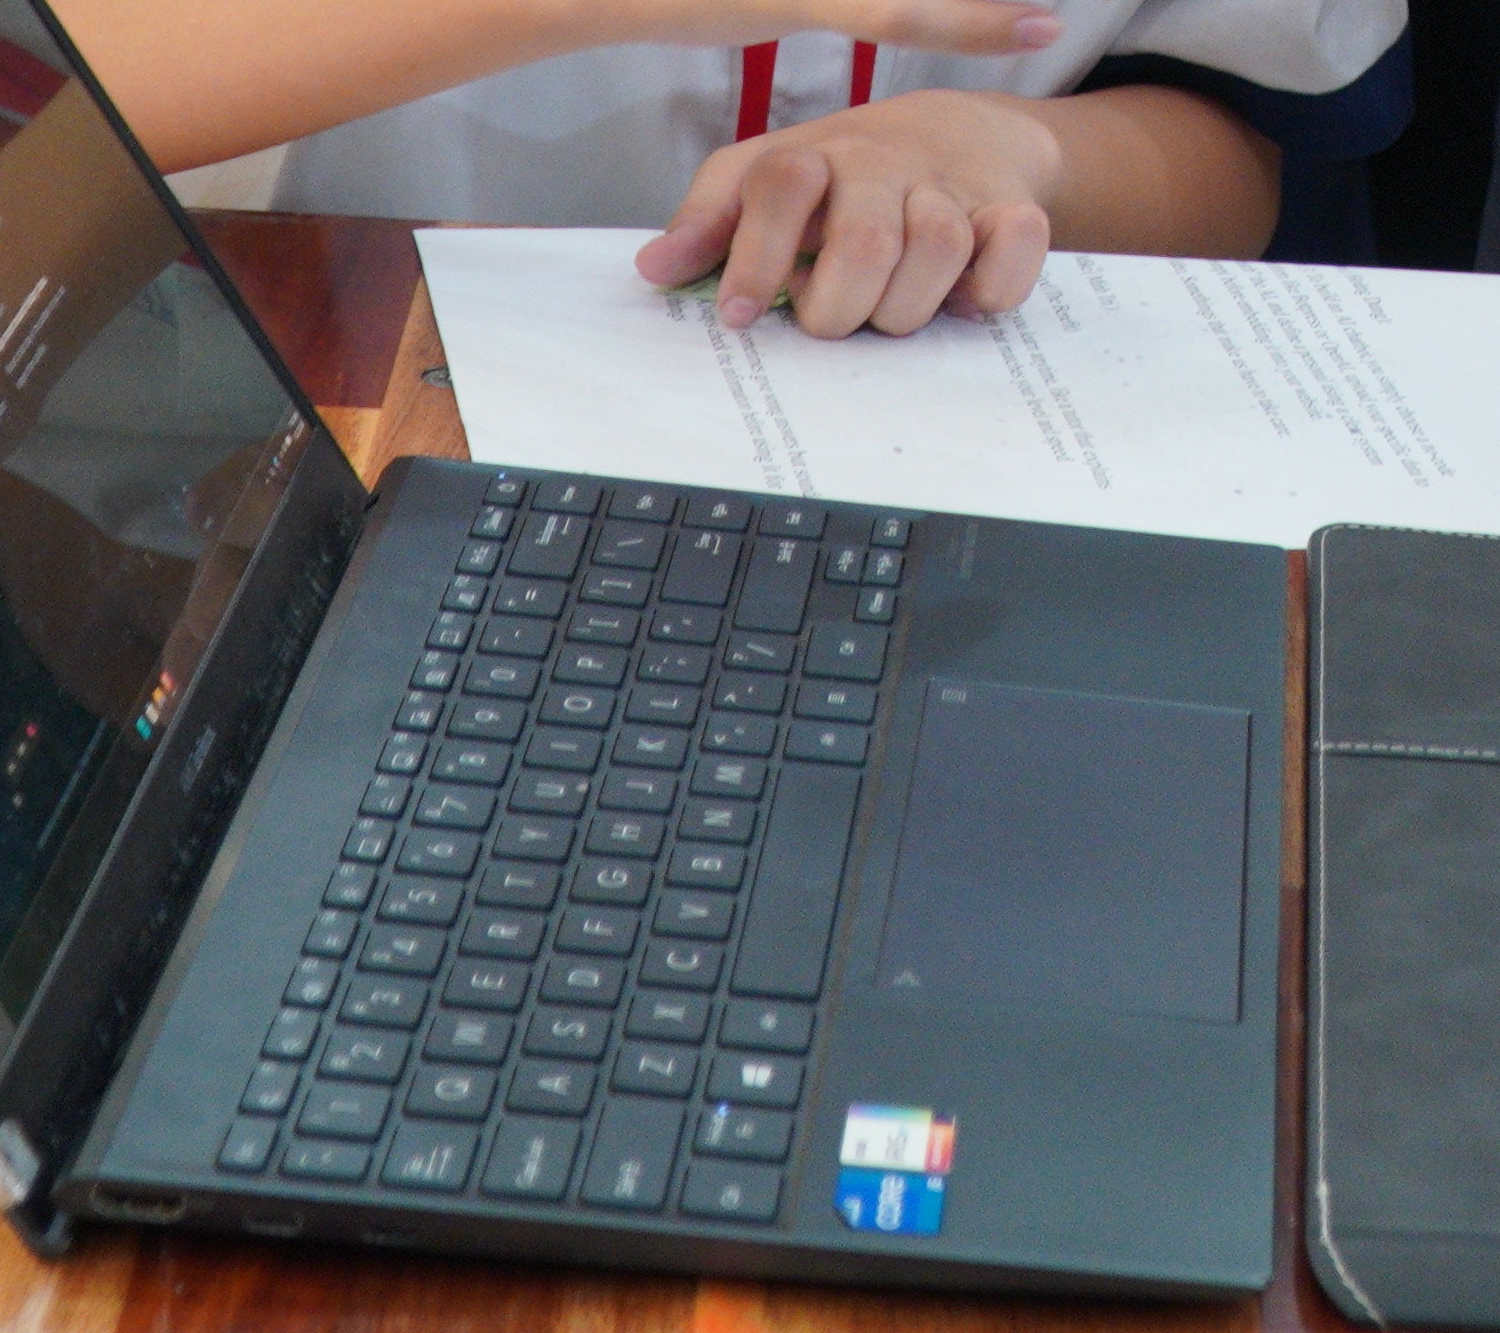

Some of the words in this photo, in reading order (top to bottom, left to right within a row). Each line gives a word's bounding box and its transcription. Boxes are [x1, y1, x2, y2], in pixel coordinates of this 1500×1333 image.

[577, 657, 603, 670] P
[563, 696, 593, 712] O
[650, 697, 678, 710] L
[636, 736, 665, 752] K
[714, 764, 745, 785] M
[535, 783, 565, 798] U
[625, 781, 653, 794] J
[703, 808, 733, 827] N
[520, 826, 548, 842] Y
[610, 822, 641, 842] H
[691, 857, 722, 872] B
[504, 873, 535, 888] T
[597, 869, 628, 888] G
[679, 903, 710, 919] V
[487, 924, 520, 940] R
[583, 918, 614, 935] F
[666, 951, 698, 972] C
[471, 972, 504, 990] E
[567, 969, 599, 988] D
[653, 1002, 687, 1021] X
[452, 1021, 487, 1046] W
[552, 1019, 586, 1039] S
[638, 1055, 674, 1077] Z
[434, 1078, 471, 1102] Q
[538, 1076, 570, 1096] A
